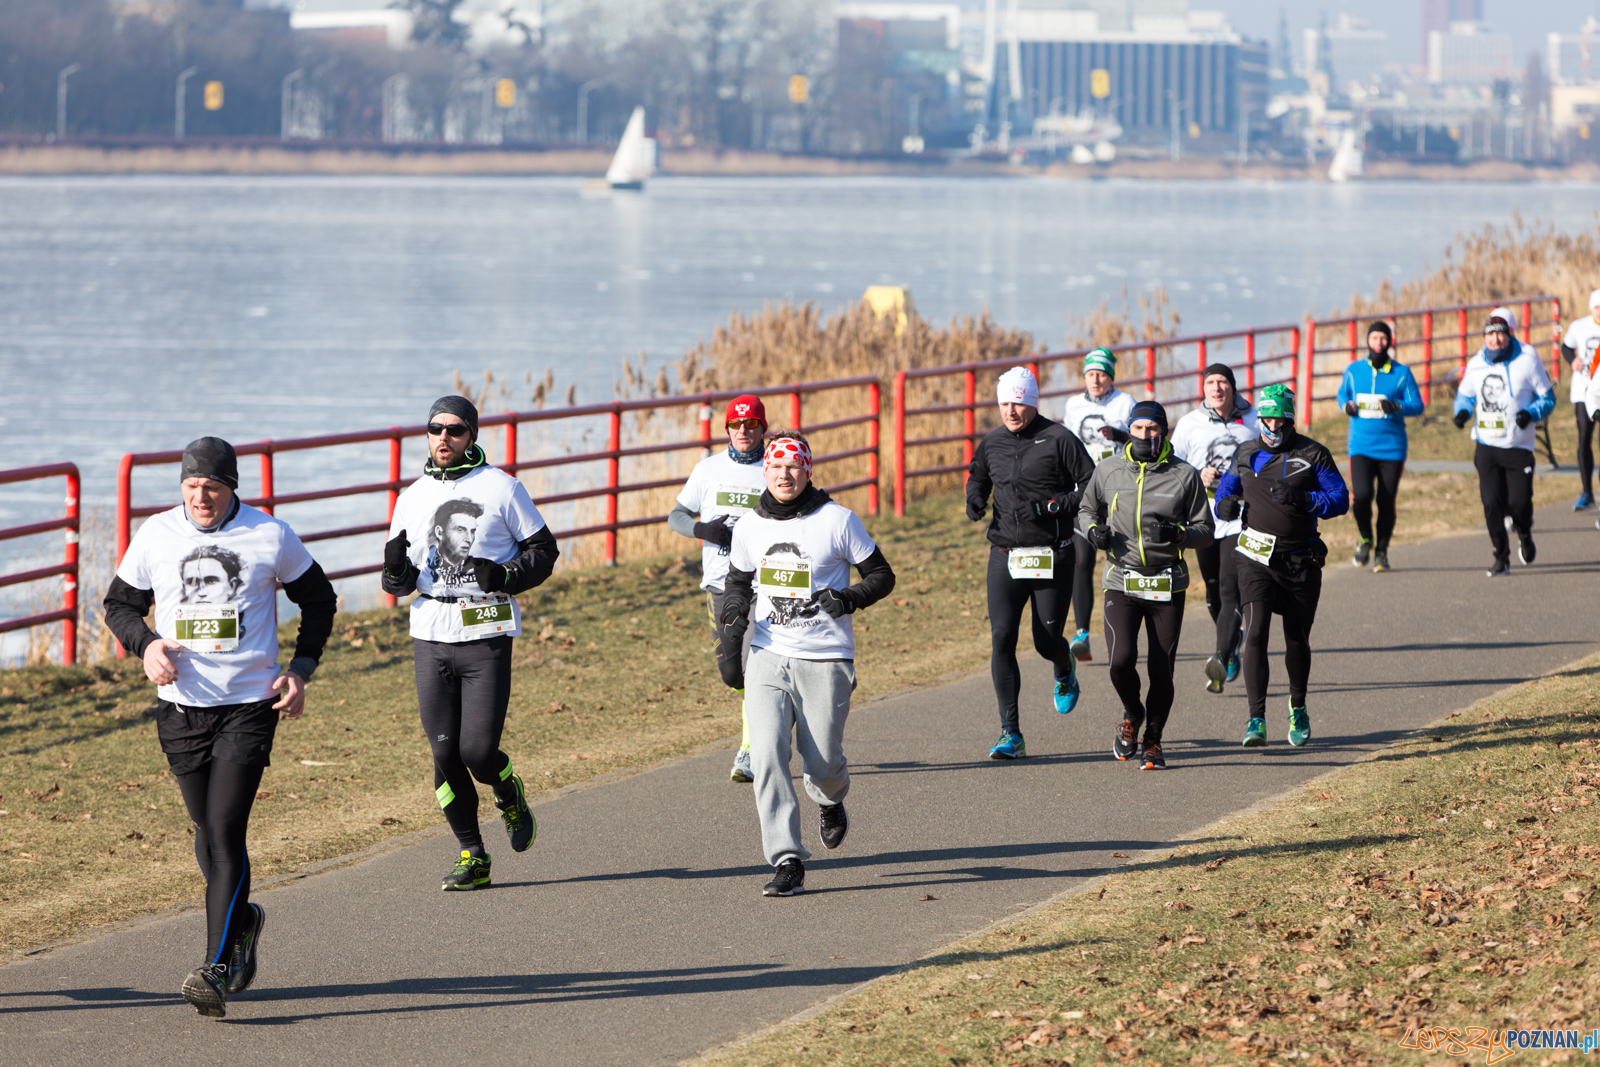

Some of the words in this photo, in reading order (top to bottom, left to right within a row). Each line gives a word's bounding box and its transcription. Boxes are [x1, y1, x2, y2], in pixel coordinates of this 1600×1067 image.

[728, 493, 749, 505] 312
[773, 570, 795, 583] 467
[1137, 578, 1158, 588] 614
[475, 606, 498, 620] 248
[193, 620, 219, 634] 223
